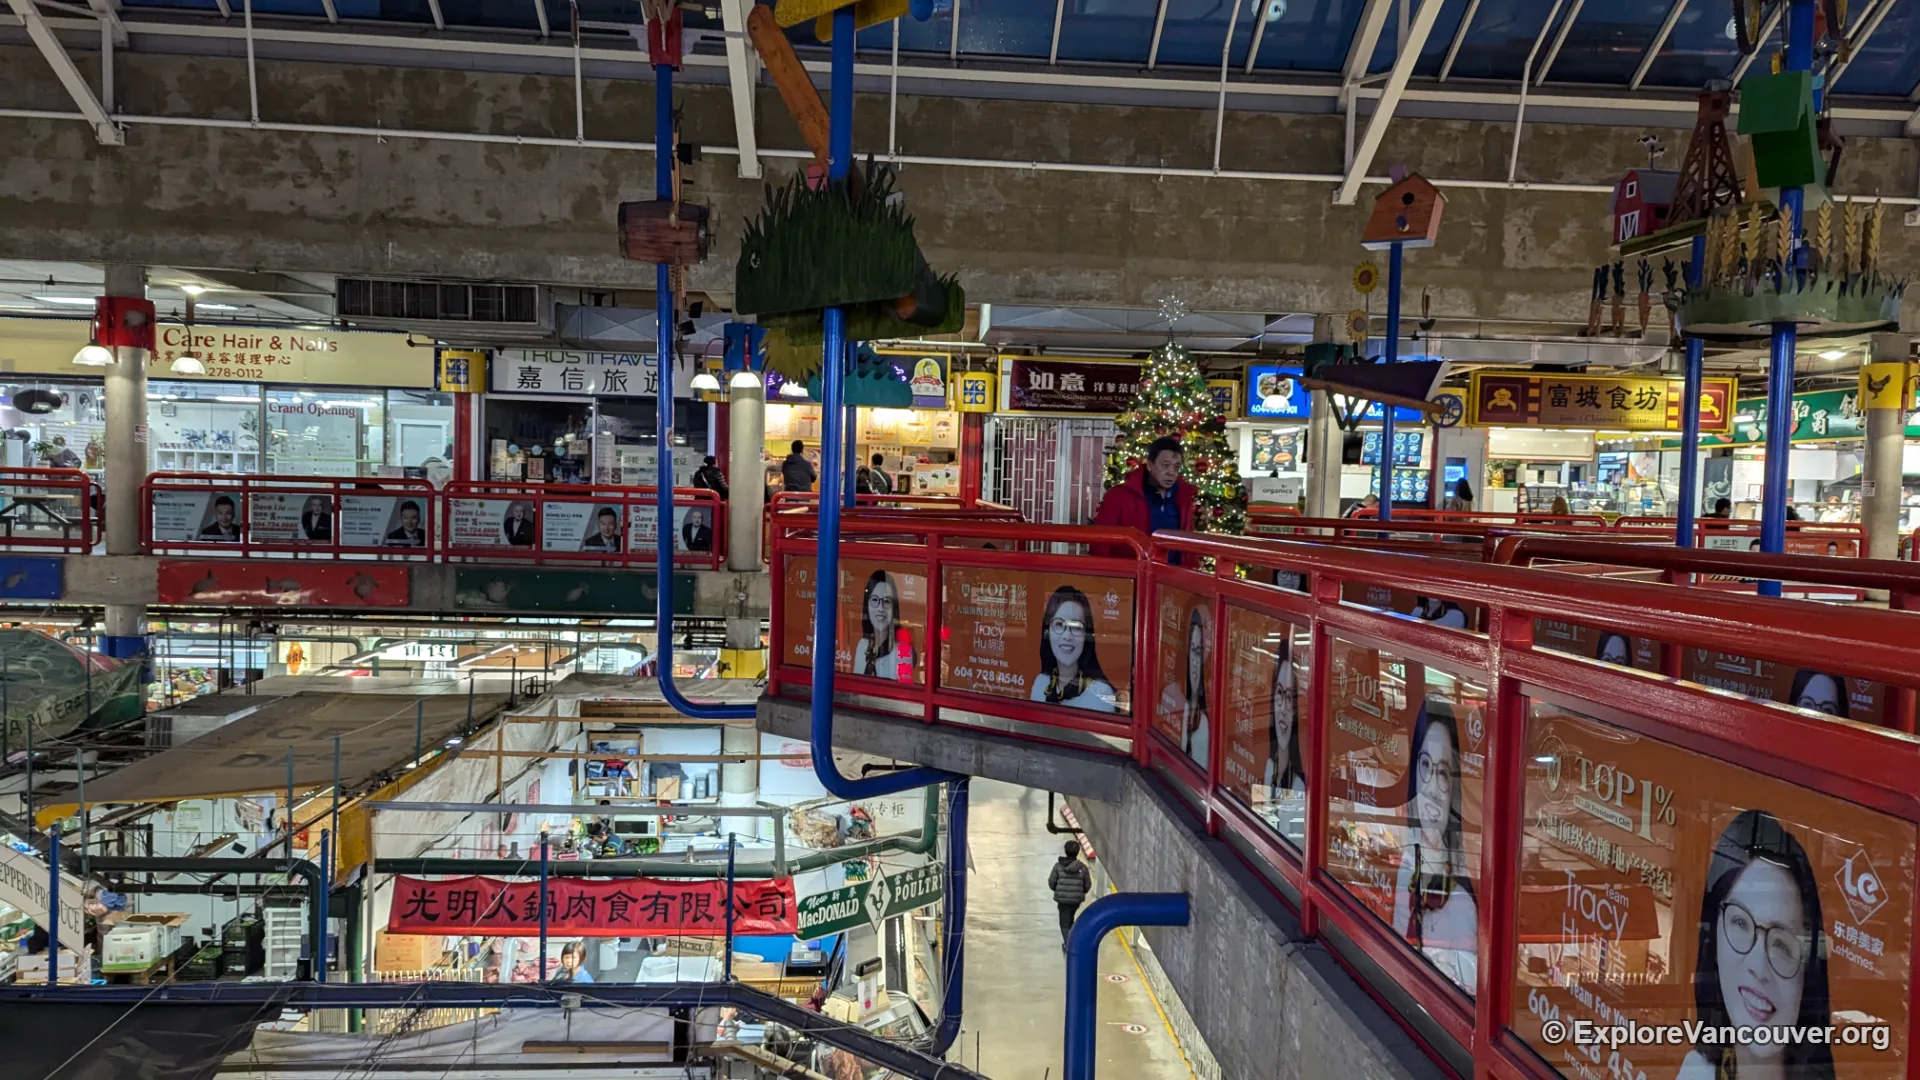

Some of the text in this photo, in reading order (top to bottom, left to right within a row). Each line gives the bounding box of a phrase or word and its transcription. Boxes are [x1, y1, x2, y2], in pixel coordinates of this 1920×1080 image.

[163, 328, 338, 352] Care Hair & Nails
[1029, 371, 1085, 392] 如意
[1548, 384, 1662, 411] 富城食坊
[269, 402, 356, 419] Grand Opening
[977, 582, 1008, 596] TOP
[973, 621, 1005, 640] Tracy
[794, 643, 852, 663] 604 546
[973, 637, 987, 650] Hu
[953, 666, 1025, 686] 604 728 4546
[1575, 754, 1676, 844] TOP 1%
[806, 895, 828, 909] New
[1604, 882, 1629, 908] Team
[798, 898, 860, 930] MacDONALD
[1564, 867, 1629, 947] Tracy
[1562, 912, 1587, 956] Hu
[667, 939, 705, 953] EXCEL
[1569, 975, 1593, 1009] Team
[1594, 995, 1611, 1022] For
